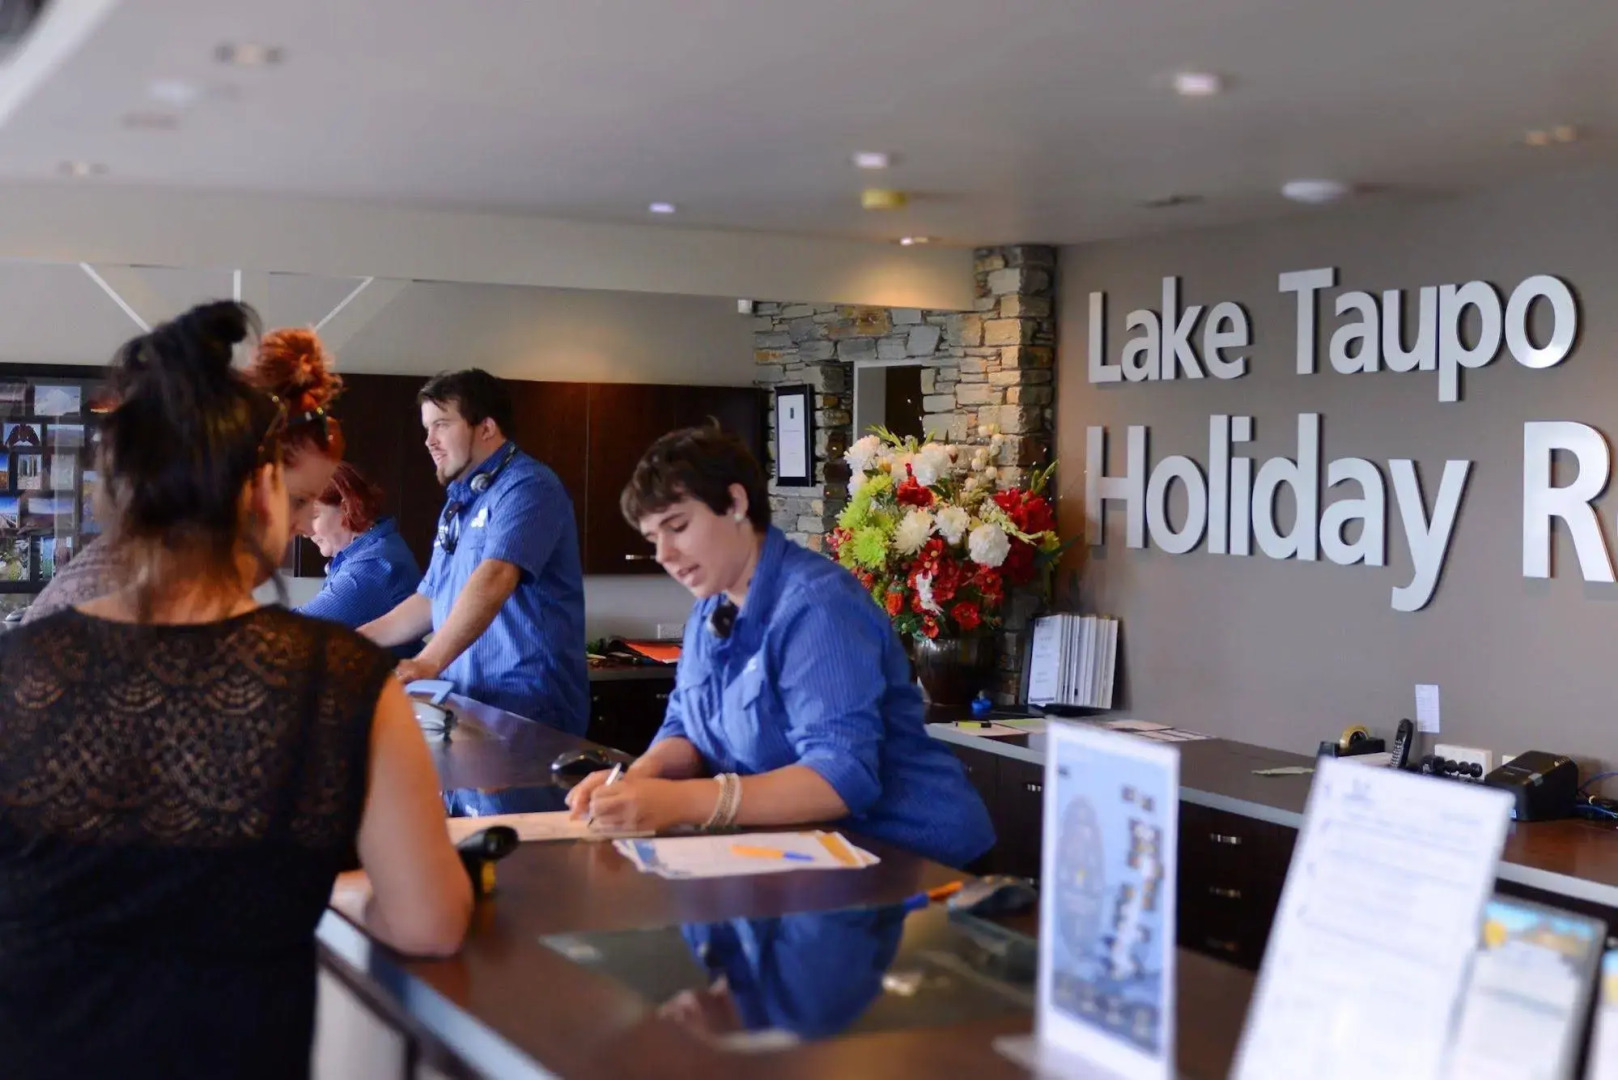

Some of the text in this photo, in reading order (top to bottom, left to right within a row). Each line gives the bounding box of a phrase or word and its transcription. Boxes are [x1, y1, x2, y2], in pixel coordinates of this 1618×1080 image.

[1088, 267, 1578, 402] Lake Taupo
[1085, 412, 1618, 612] Holiday R
